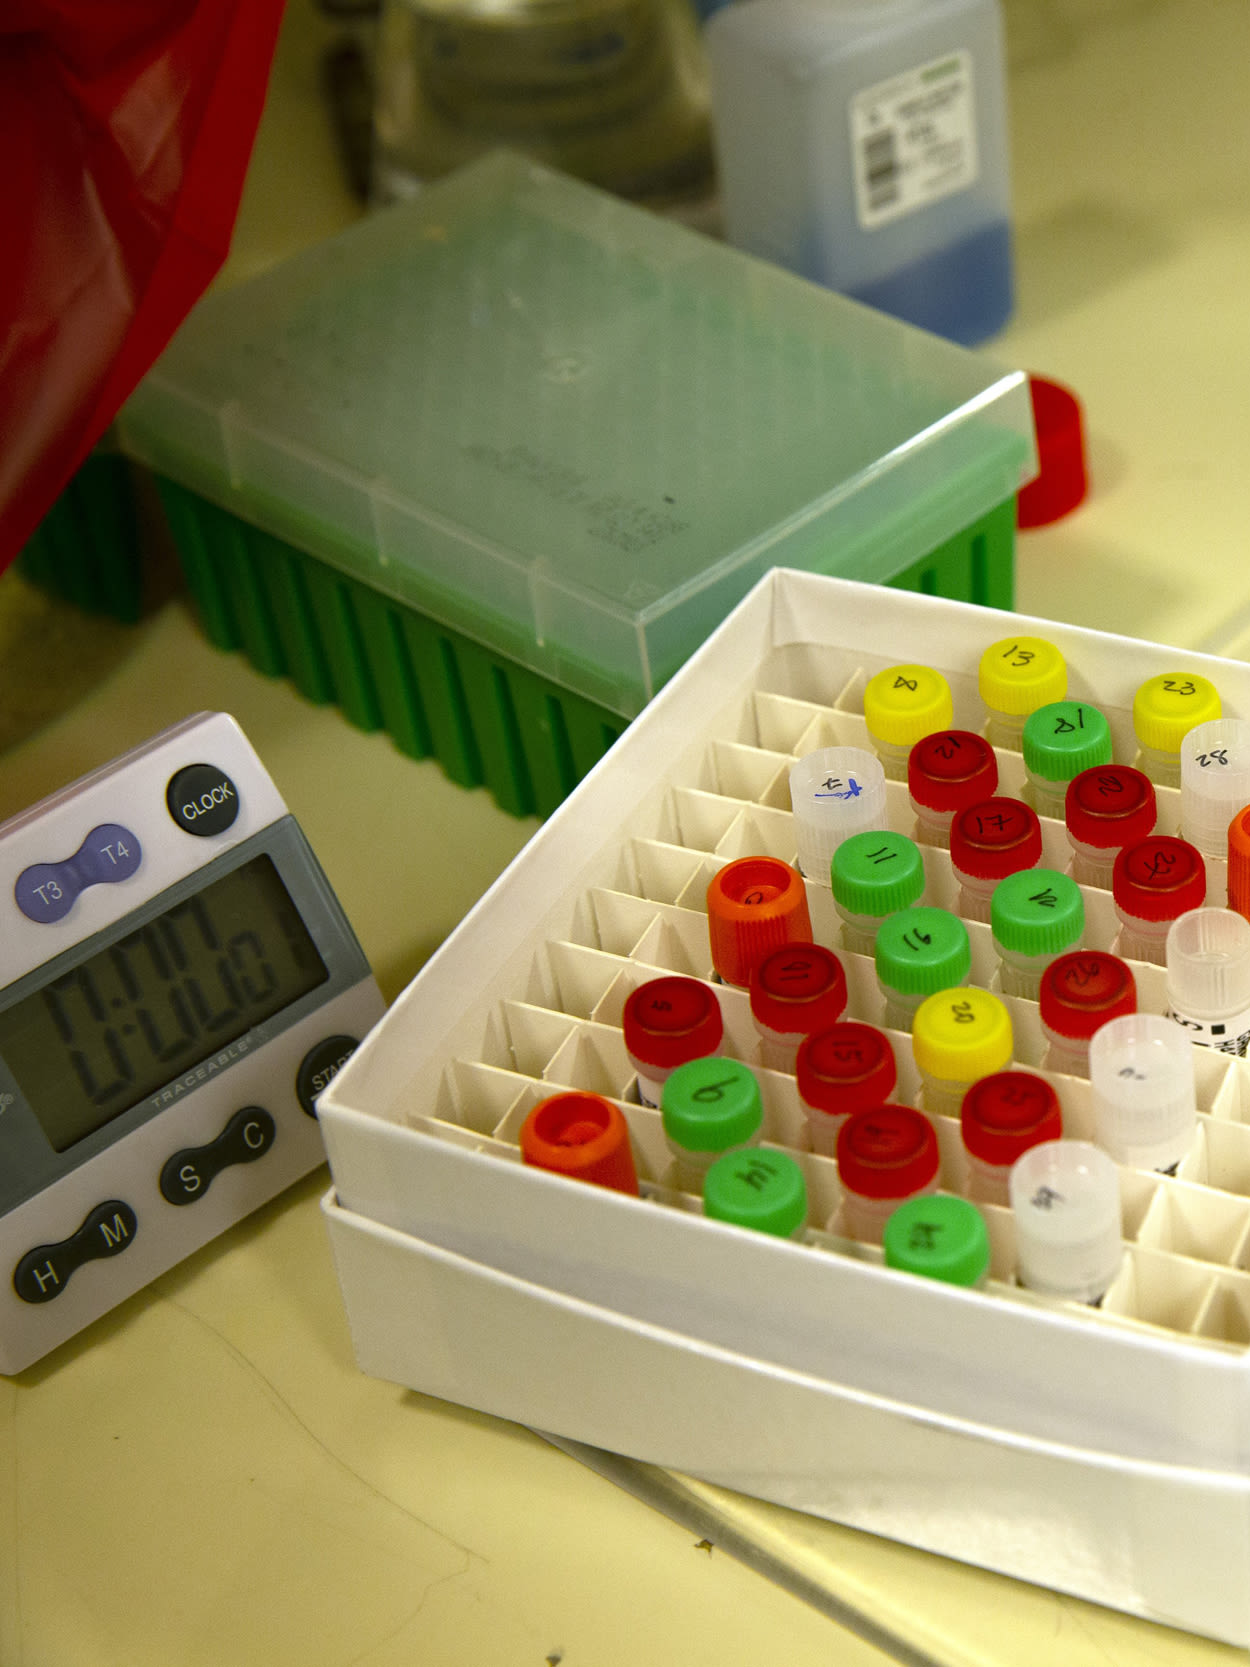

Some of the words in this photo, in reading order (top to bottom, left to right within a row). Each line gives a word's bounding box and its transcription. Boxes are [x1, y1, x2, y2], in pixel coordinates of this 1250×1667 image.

[1002, 644, 1035, 667] 13
[892, 675, 919, 692] 8
[1163, 679, 1197, 697] 23
[935, 736, 961, 760] 12
[1195, 748, 1229, 768] 28
[181, 781, 235, 820] CLOCK
[976, 815, 1012, 835] 17
[100, 840, 130, 866] T4
[866, 846, 897, 865] 11
[1143, 850, 1177, 881] 27
[32, 881, 64, 905] T3
[903, 927, 933, 952] 16
[951, 1001, 976, 1025] 20
[242, 1121, 265, 1149] C
[179, 1165, 201, 1192] S
[735, 1158, 779, 1193] 14
[98, 1213, 129, 1248] M
[32, 1260, 60, 1293] H
